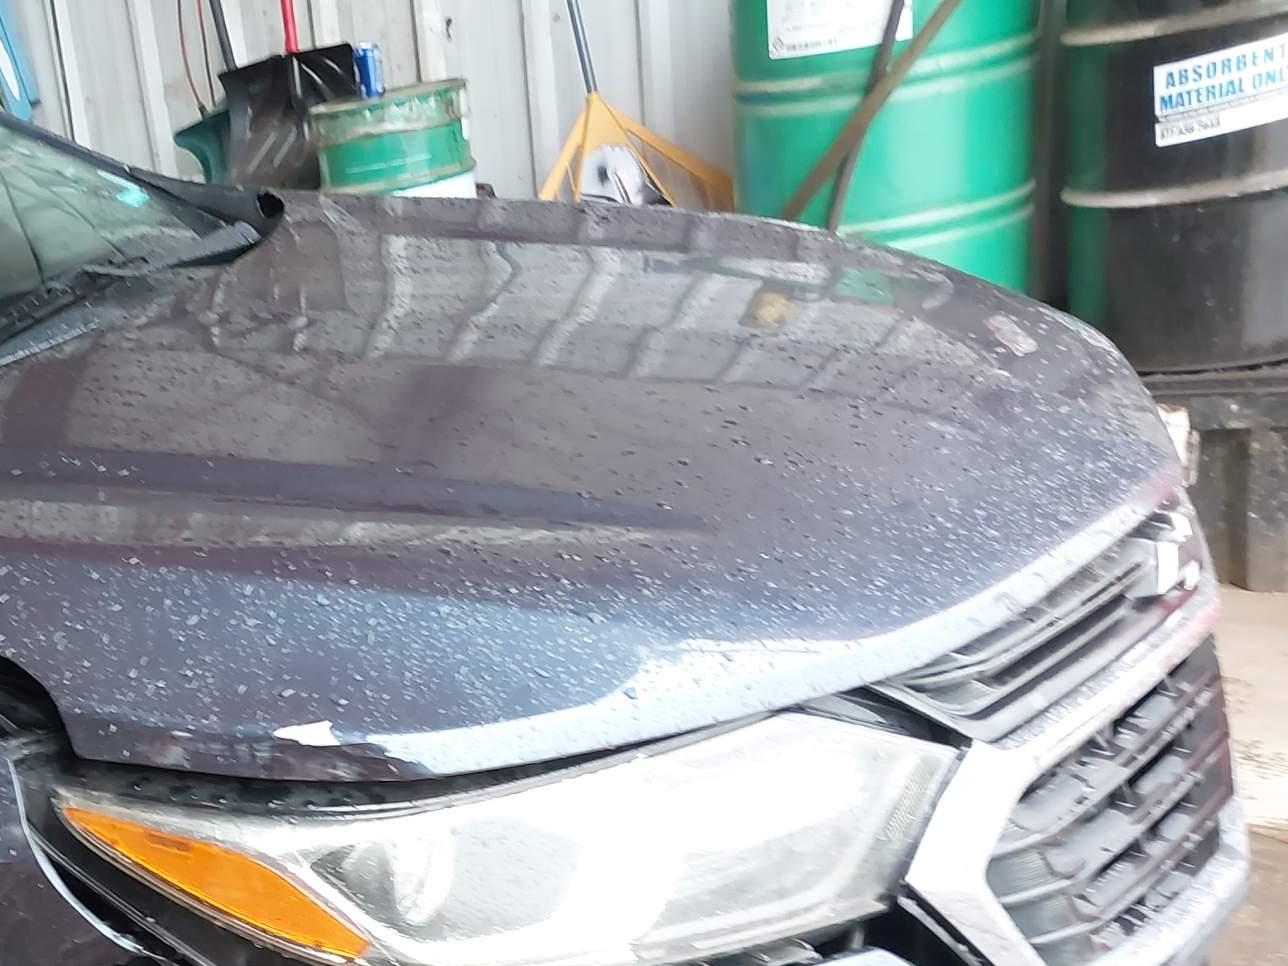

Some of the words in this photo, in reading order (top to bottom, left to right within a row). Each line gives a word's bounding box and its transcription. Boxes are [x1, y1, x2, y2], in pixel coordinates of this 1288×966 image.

[1160, 77, 1244, 112] MATERIAL
[1252, 65, 1288, 90] ONL
[1165, 43, 1287, 88] ABSORBENT
